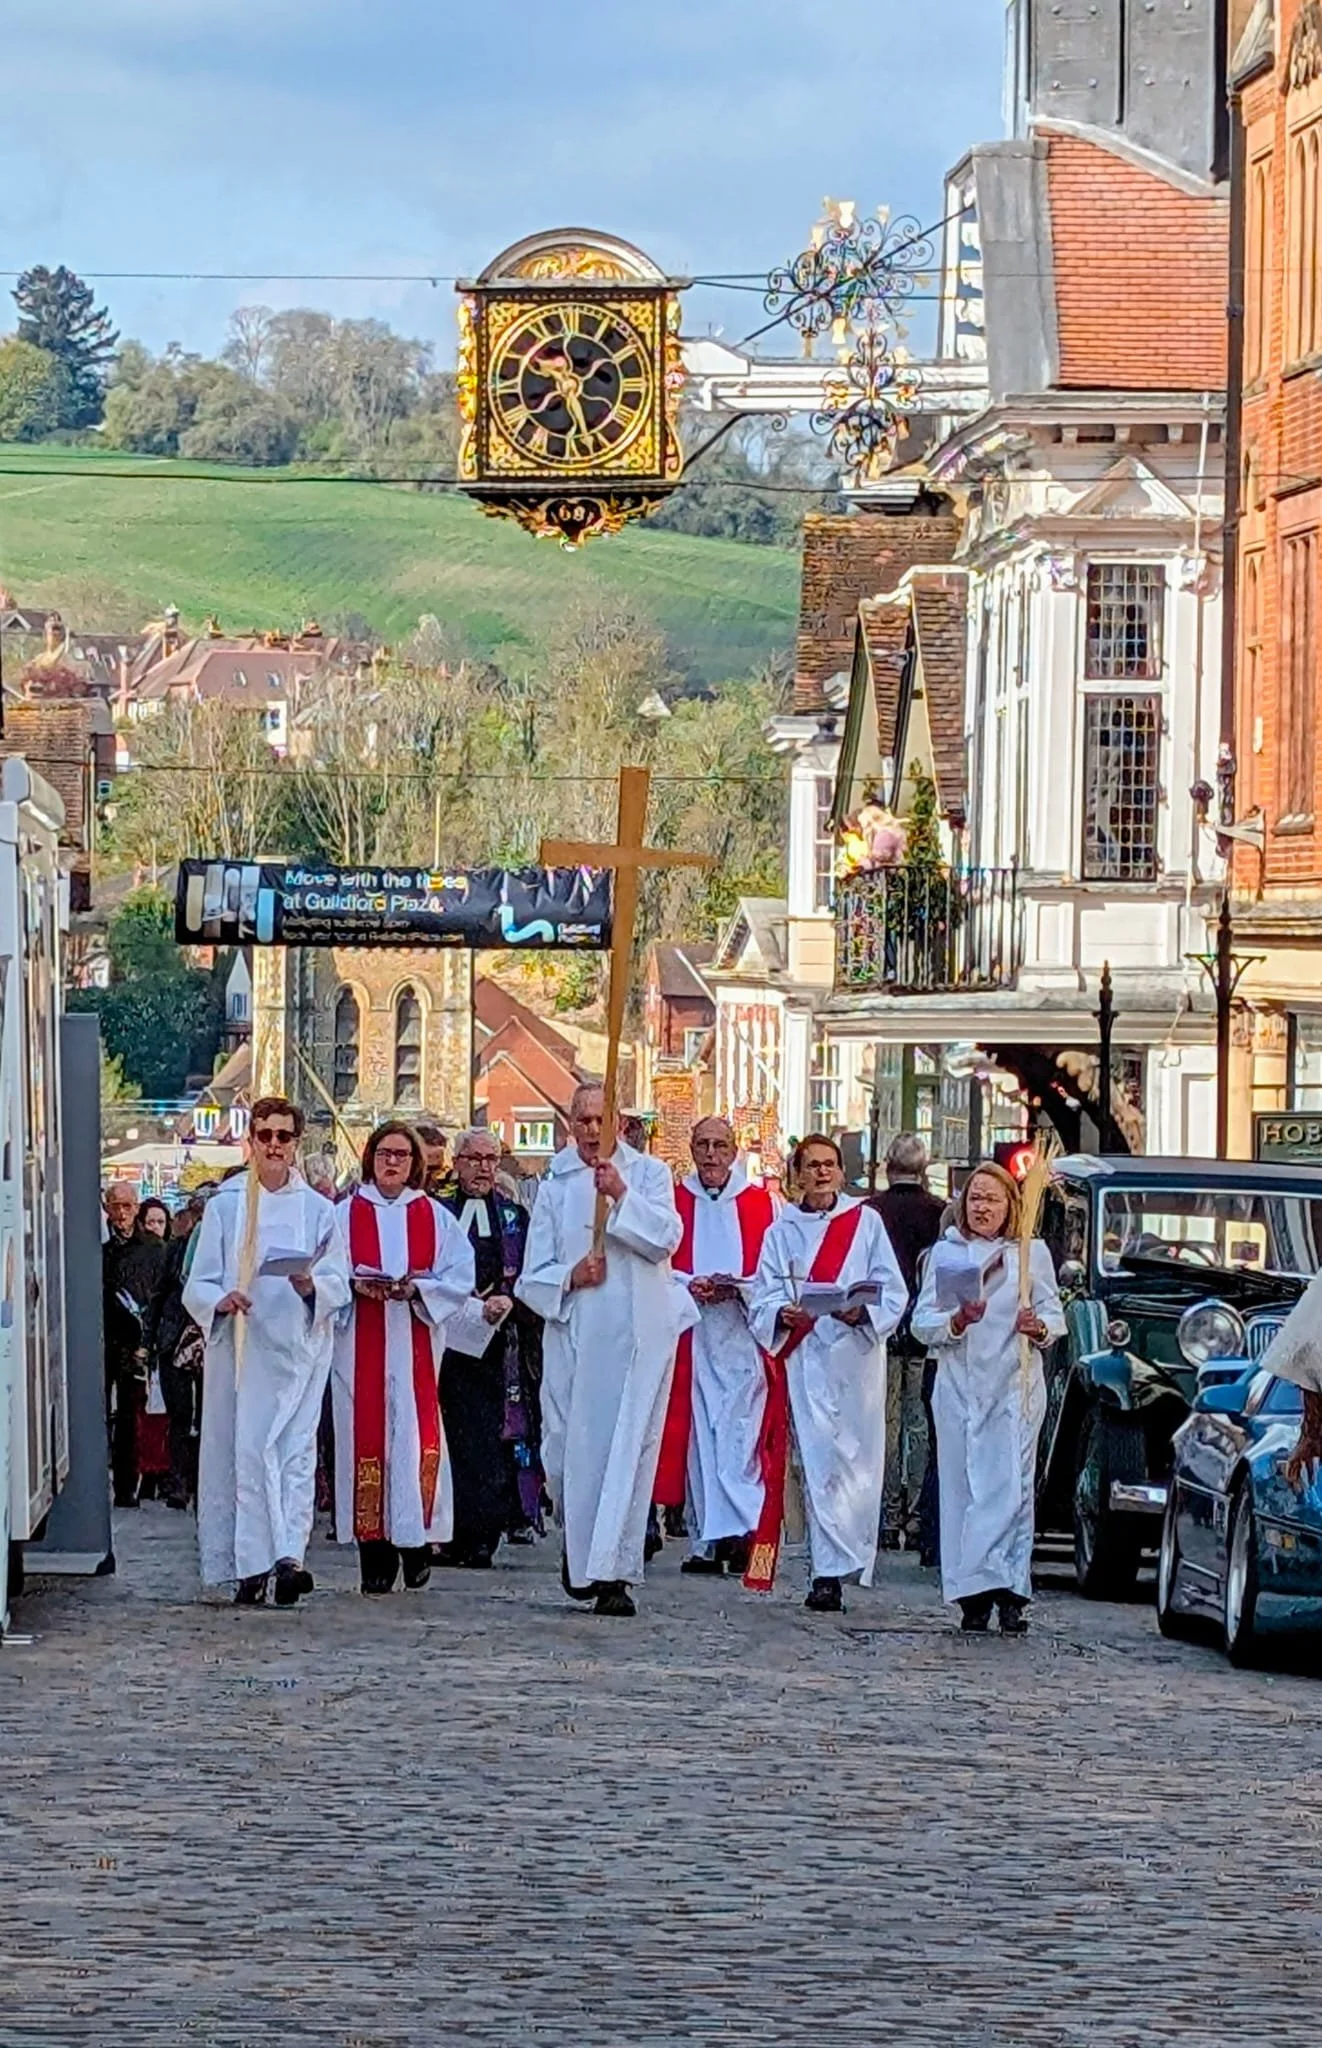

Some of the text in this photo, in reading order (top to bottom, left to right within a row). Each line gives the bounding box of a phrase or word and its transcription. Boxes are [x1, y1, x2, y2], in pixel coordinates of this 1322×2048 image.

[286, 869, 337, 886] Move
[382, 871, 412, 888] the
[283, 893, 301, 909] at
